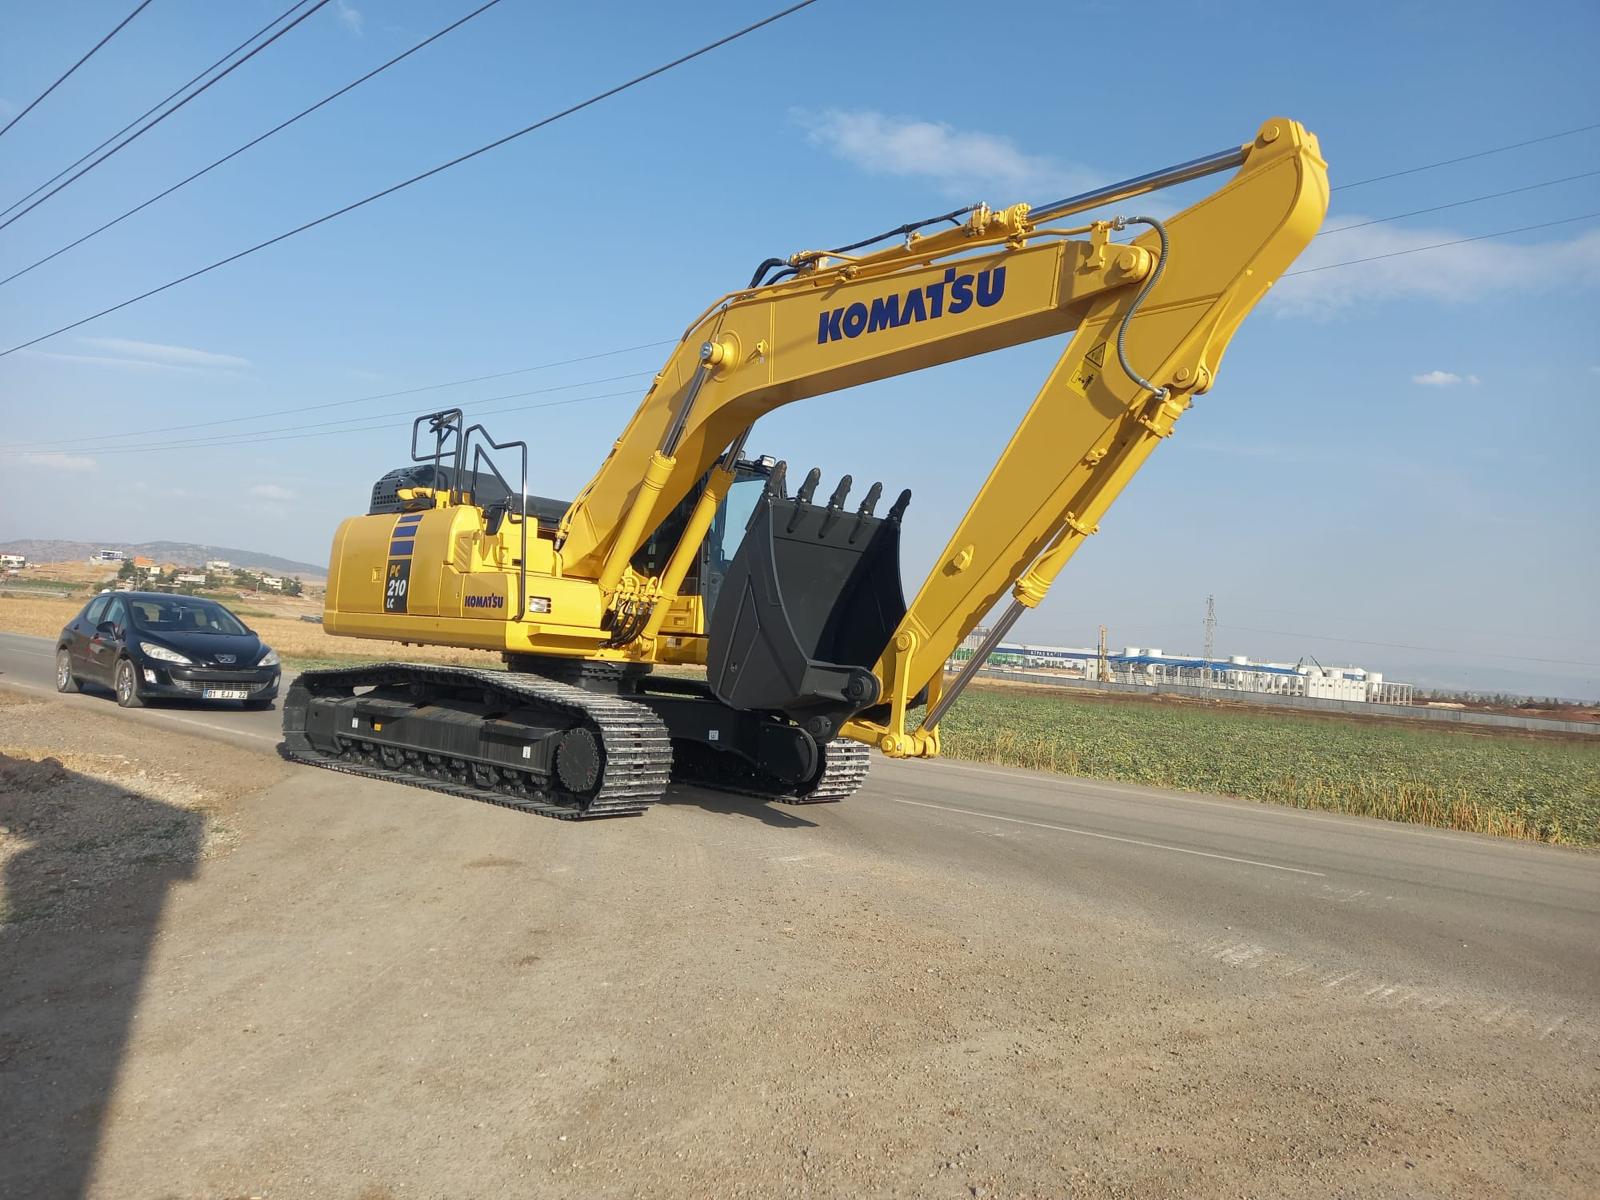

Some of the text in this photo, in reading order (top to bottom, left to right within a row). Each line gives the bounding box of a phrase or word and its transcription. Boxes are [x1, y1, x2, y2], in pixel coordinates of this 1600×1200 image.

[818, 266, 1006, 344] KOMATSU
[389, 564, 401, 577] PC
[387, 579, 407, 597] 210
[386, 598, 394, 609] LC
[464, 593, 504, 608] KOMATSU
